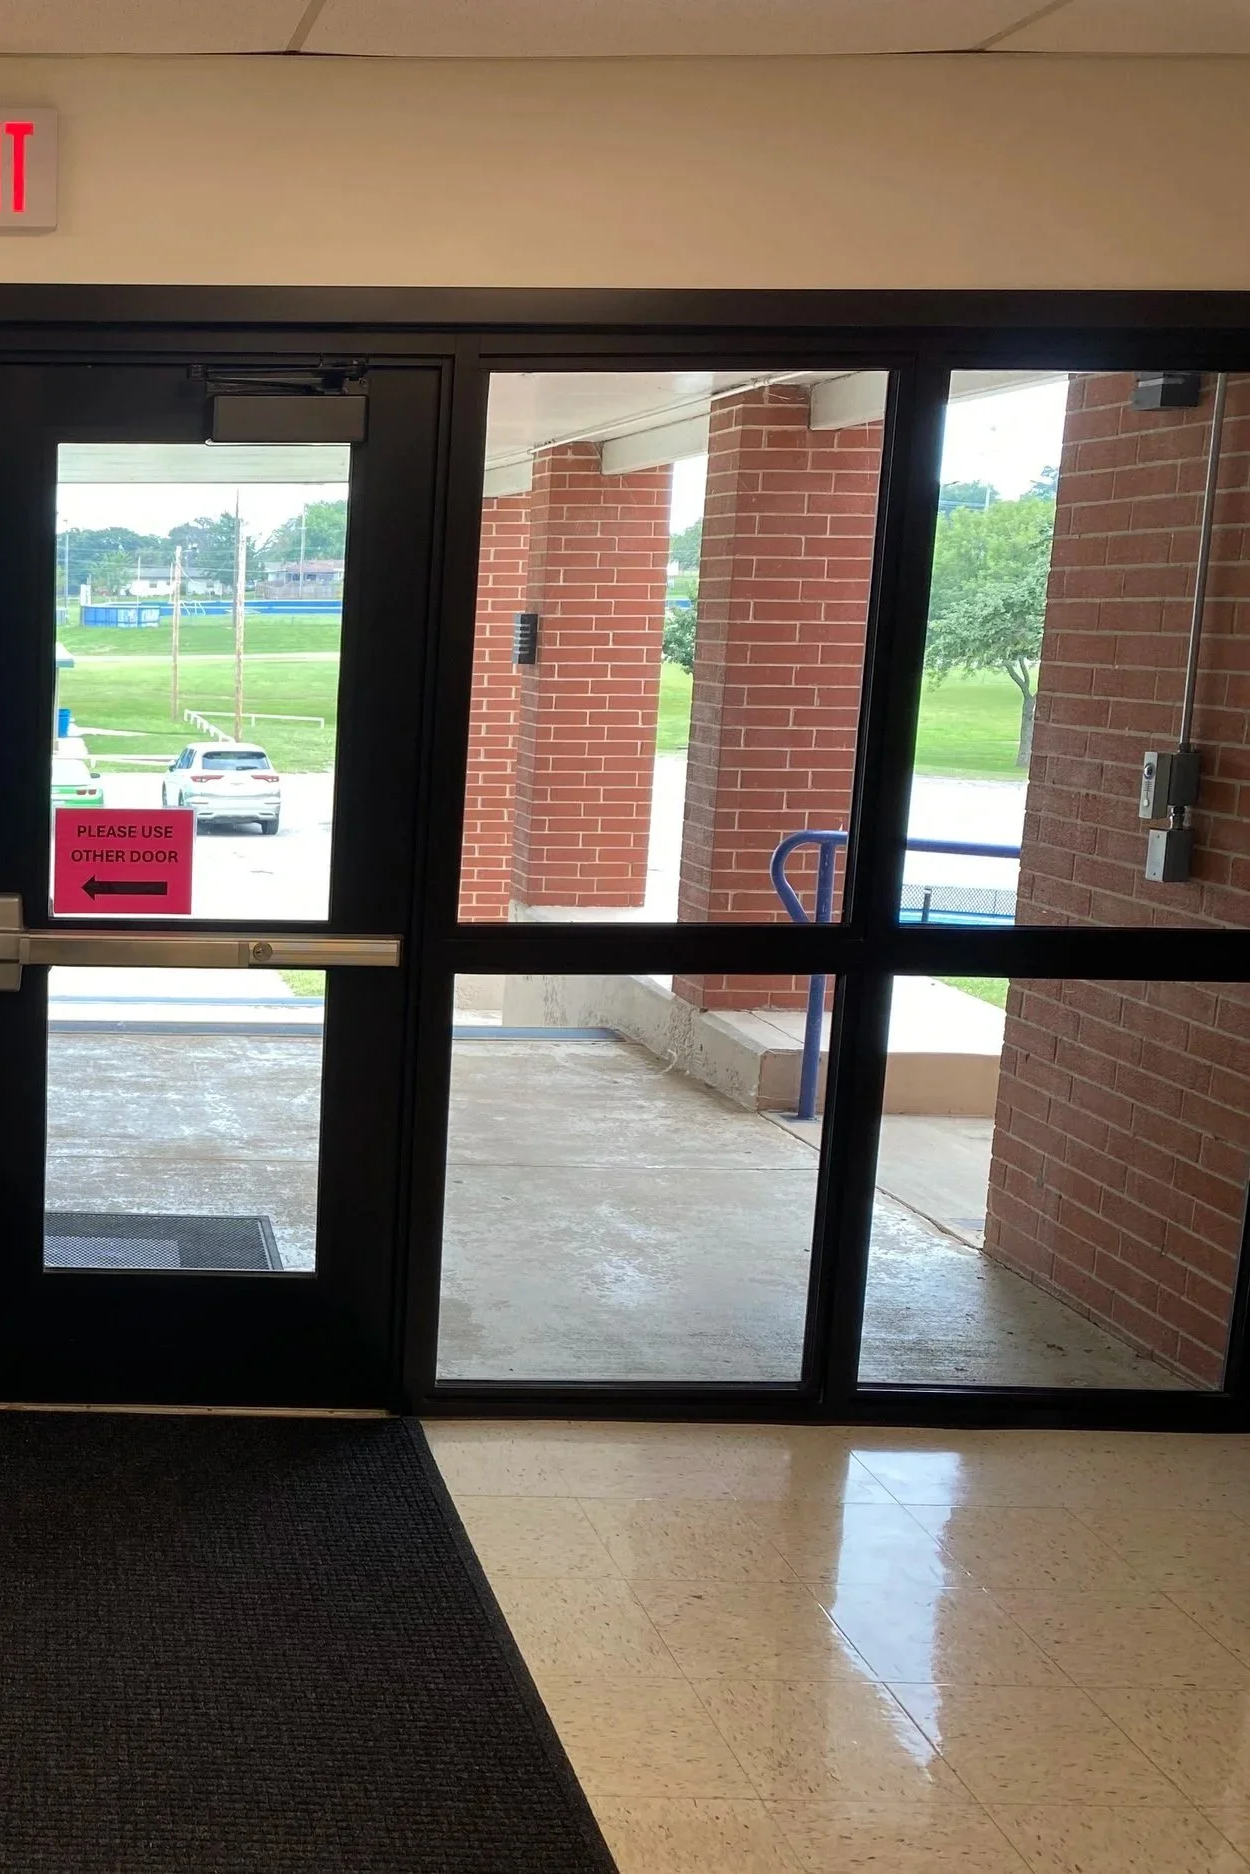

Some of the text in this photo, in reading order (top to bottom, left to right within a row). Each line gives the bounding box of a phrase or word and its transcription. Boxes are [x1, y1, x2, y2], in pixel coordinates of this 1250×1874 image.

[77, 825, 173, 838] PLEASE USE
[71, 850, 178, 863] OTHER DOOR
